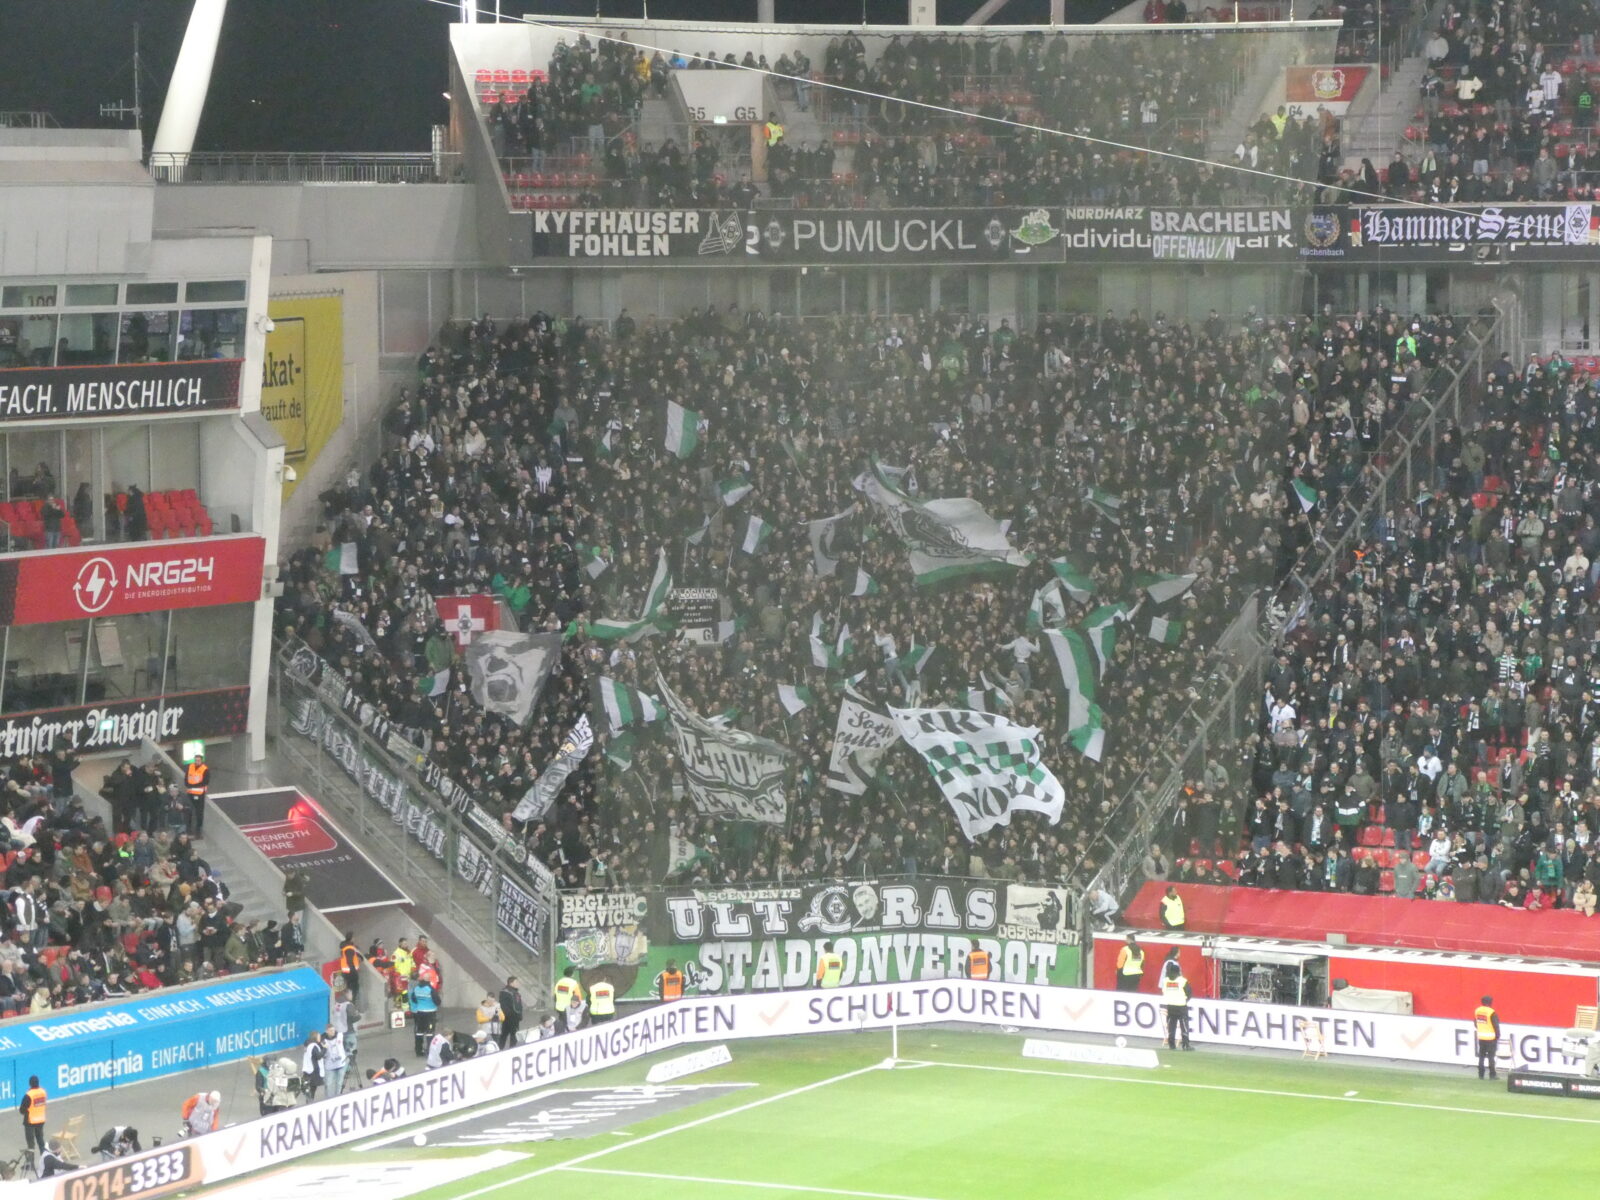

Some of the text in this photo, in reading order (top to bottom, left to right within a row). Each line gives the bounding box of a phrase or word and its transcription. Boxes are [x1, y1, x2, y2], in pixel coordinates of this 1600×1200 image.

[735, 107, 757, 120] G5
[1289, 105, 1303, 117] G4
[535, 211, 699, 234] KYFFHÄUSER
[1066, 208, 1143, 220] NORDHARZ
[1151, 211, 1291, 233] BRACHELEN
[1365, 207, 1565, 242] Hammer Szene
[569, 235, 670, 256] FOHLEN
[794, 219, 976, 252] PUMUCKL
[67, 377, 206, 412] MENSCHLICH.
[126, 557, 214, 588] NRG24
[561, 893, 637, 913] BEGLEIT
[561, 909, 637, 928] SERVICE
[29, 1010, 137, 1042] Barmenia
[139, 998, 209, 1021] EINFACH.
[213, 978, 305, 1008] MENSCHLICH.
[58, 1050, 143, 1089] Barmenia
[216, 1021, 300, 1055] MENSCHLICH.
[260, 1070, 467, 1158] KRANKENFAHRTEN
[511, 1003, 736, 1085] RECHNUNGSFAHRTEN
[808, 986, 1041, 1024] SCHULTOUREN
[71, 1150, 184, 1200] 0214-3333
